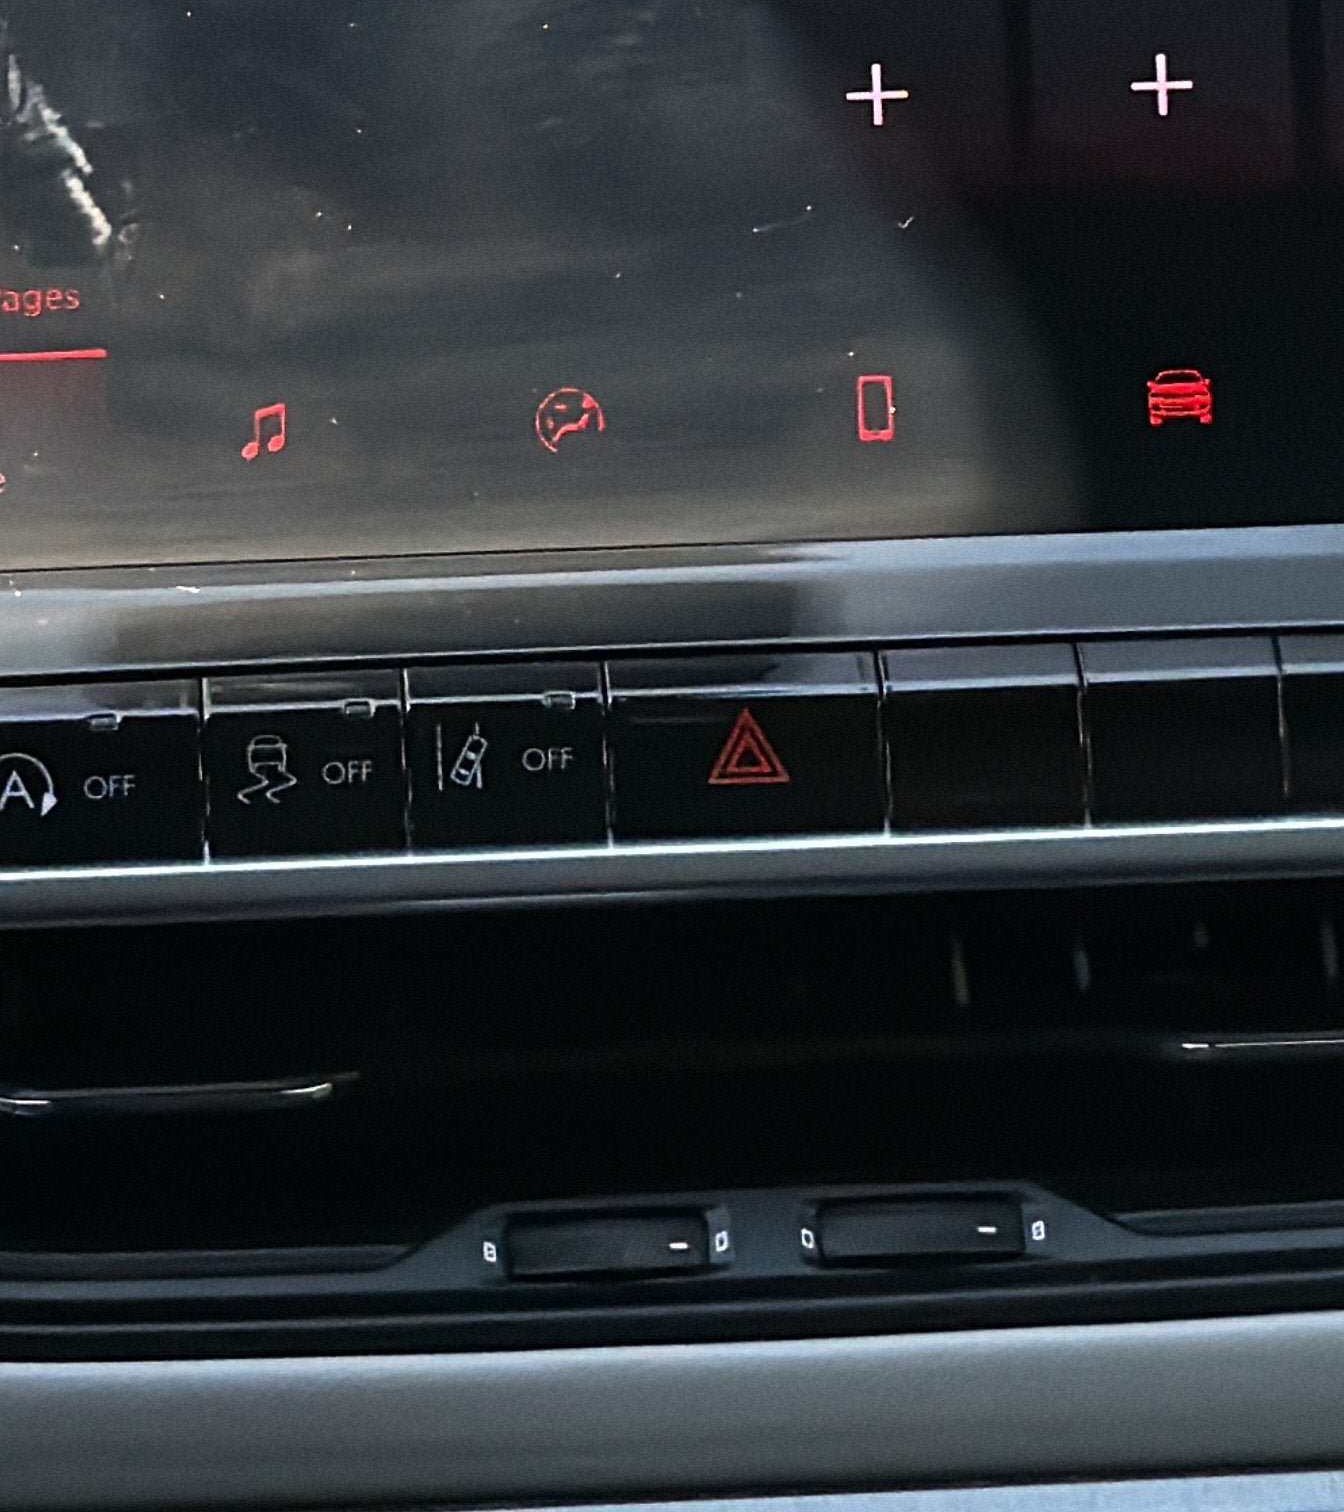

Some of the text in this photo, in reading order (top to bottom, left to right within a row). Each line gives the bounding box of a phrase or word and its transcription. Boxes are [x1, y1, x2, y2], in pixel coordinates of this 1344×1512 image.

[523, 747, 572, 770] OFF
[323, 761, 371, 784] OFF
[84, 775, 135, 799] OFF
